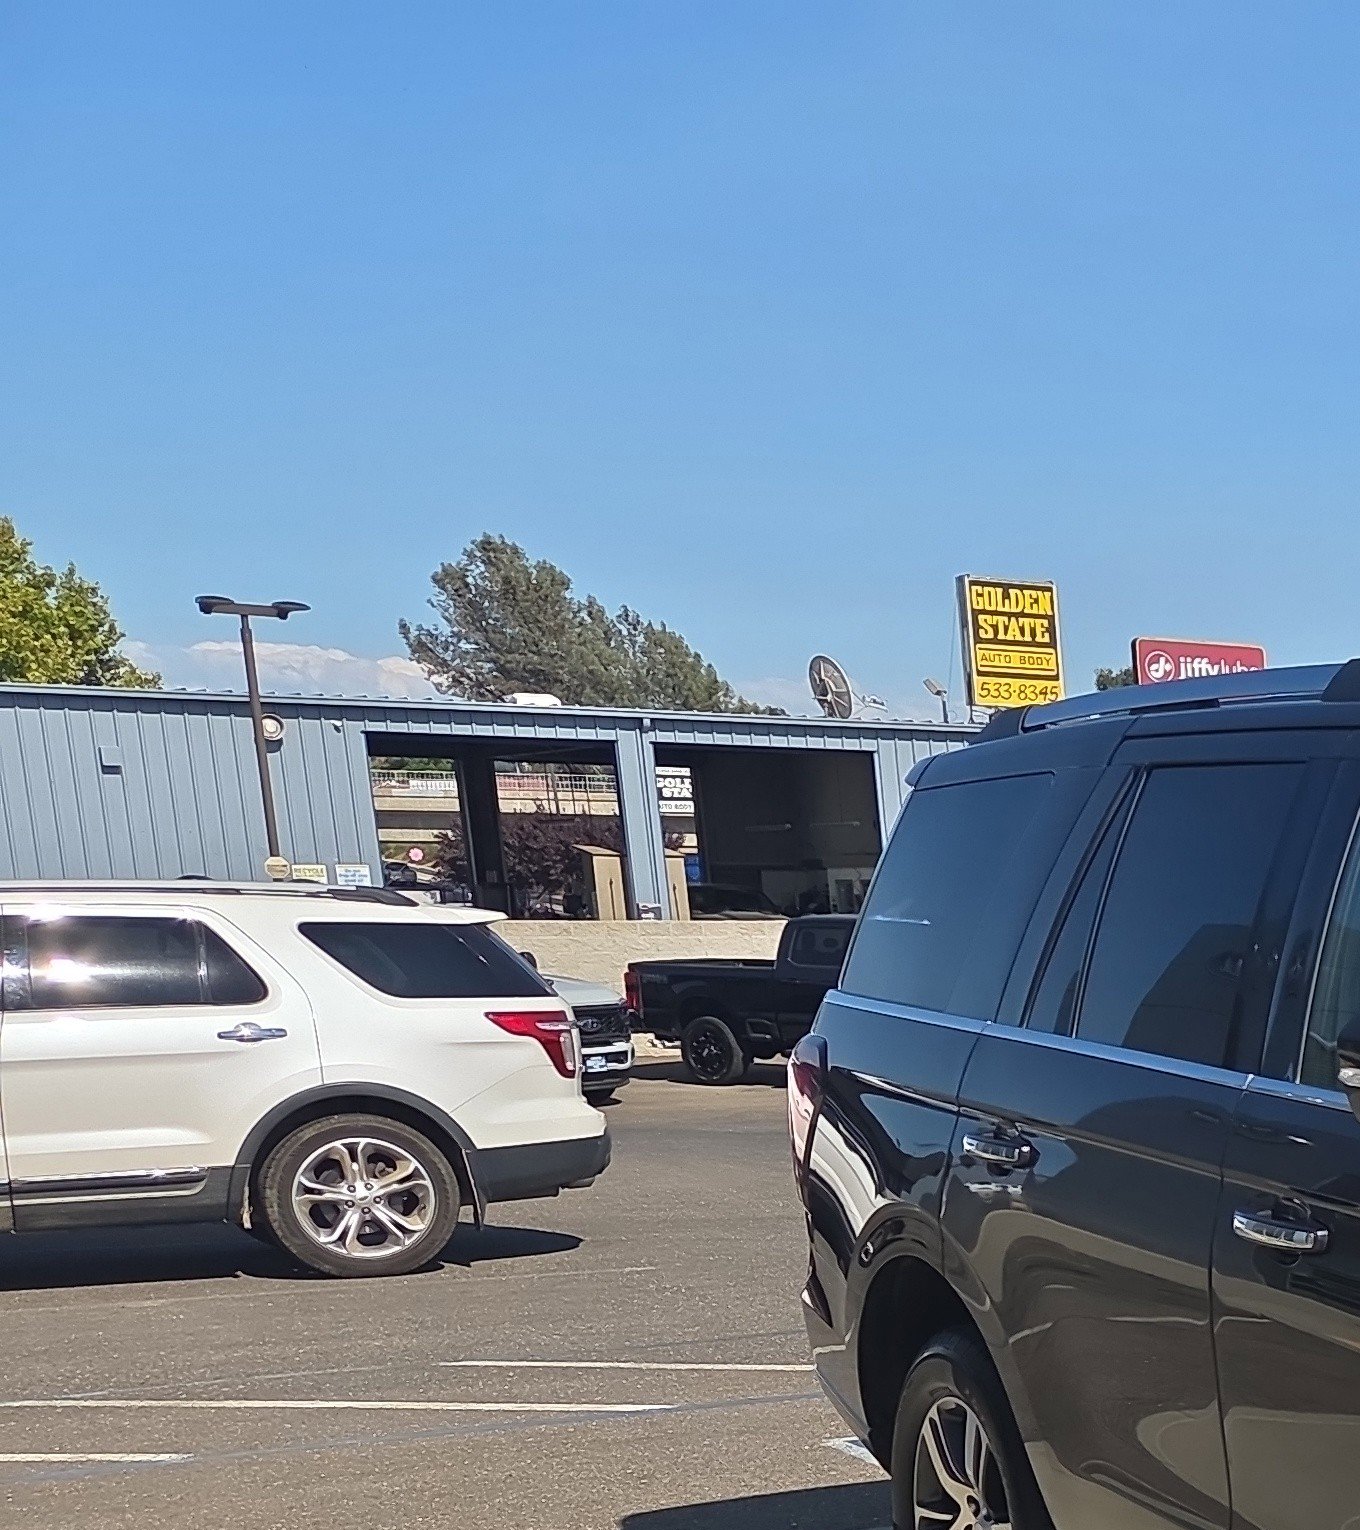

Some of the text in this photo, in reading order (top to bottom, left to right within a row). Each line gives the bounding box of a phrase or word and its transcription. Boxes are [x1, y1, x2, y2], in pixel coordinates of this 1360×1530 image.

[971, 585, 1053, 615] GOLDEN
[978, 614, 1050, 643] STATE
[980, 653, 1051, 666] AUTO BODY
